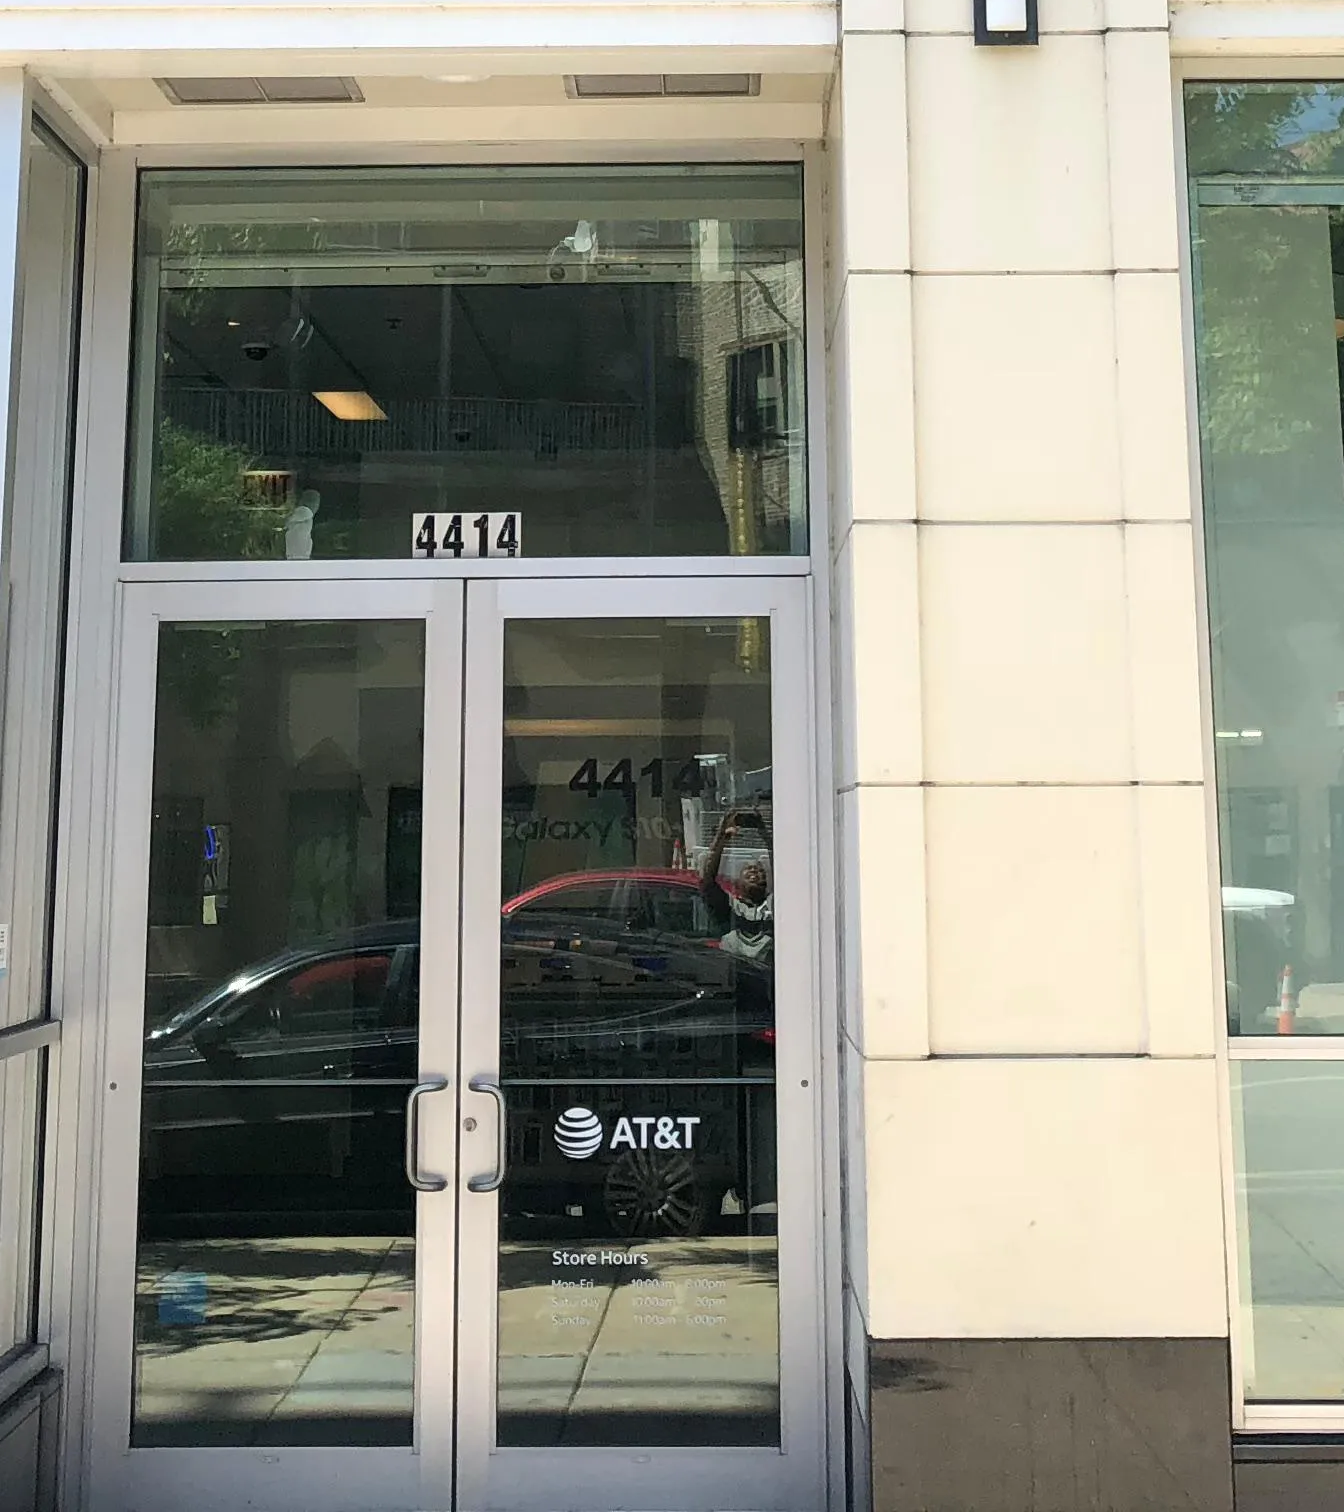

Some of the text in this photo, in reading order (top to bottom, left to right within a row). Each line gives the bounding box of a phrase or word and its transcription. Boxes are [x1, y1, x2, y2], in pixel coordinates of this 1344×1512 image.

[415, 513, 519, 558] 4414
[569, 757, 705, 798] 4414
[609, 1116, 701, 1150] AT&T
[551, 1250, 649, 1266] Store Hours
